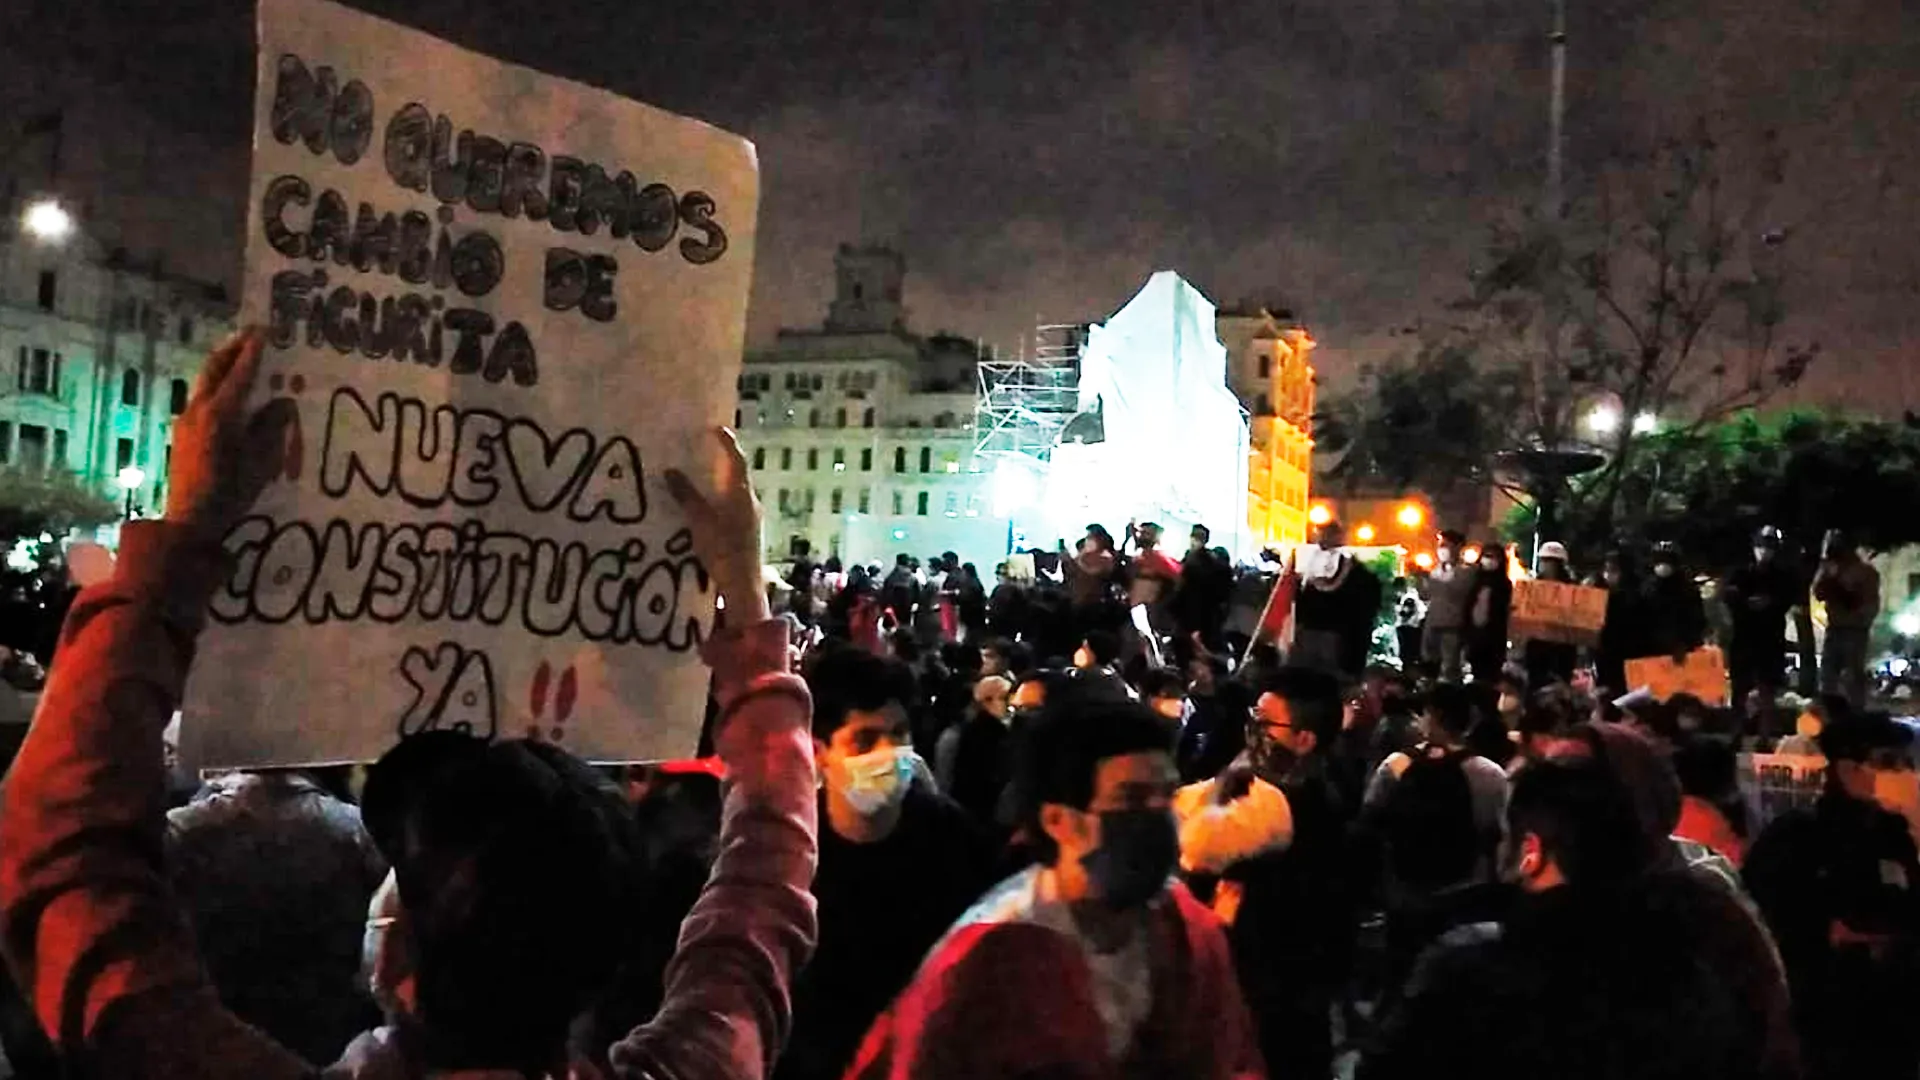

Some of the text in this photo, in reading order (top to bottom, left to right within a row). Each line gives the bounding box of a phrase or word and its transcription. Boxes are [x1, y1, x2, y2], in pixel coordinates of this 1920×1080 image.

[272, 53, 728, 265] NO QUEREMOS
[543, 247, 619, 323] DE
[320, 386, 647, 524] NUEVA
